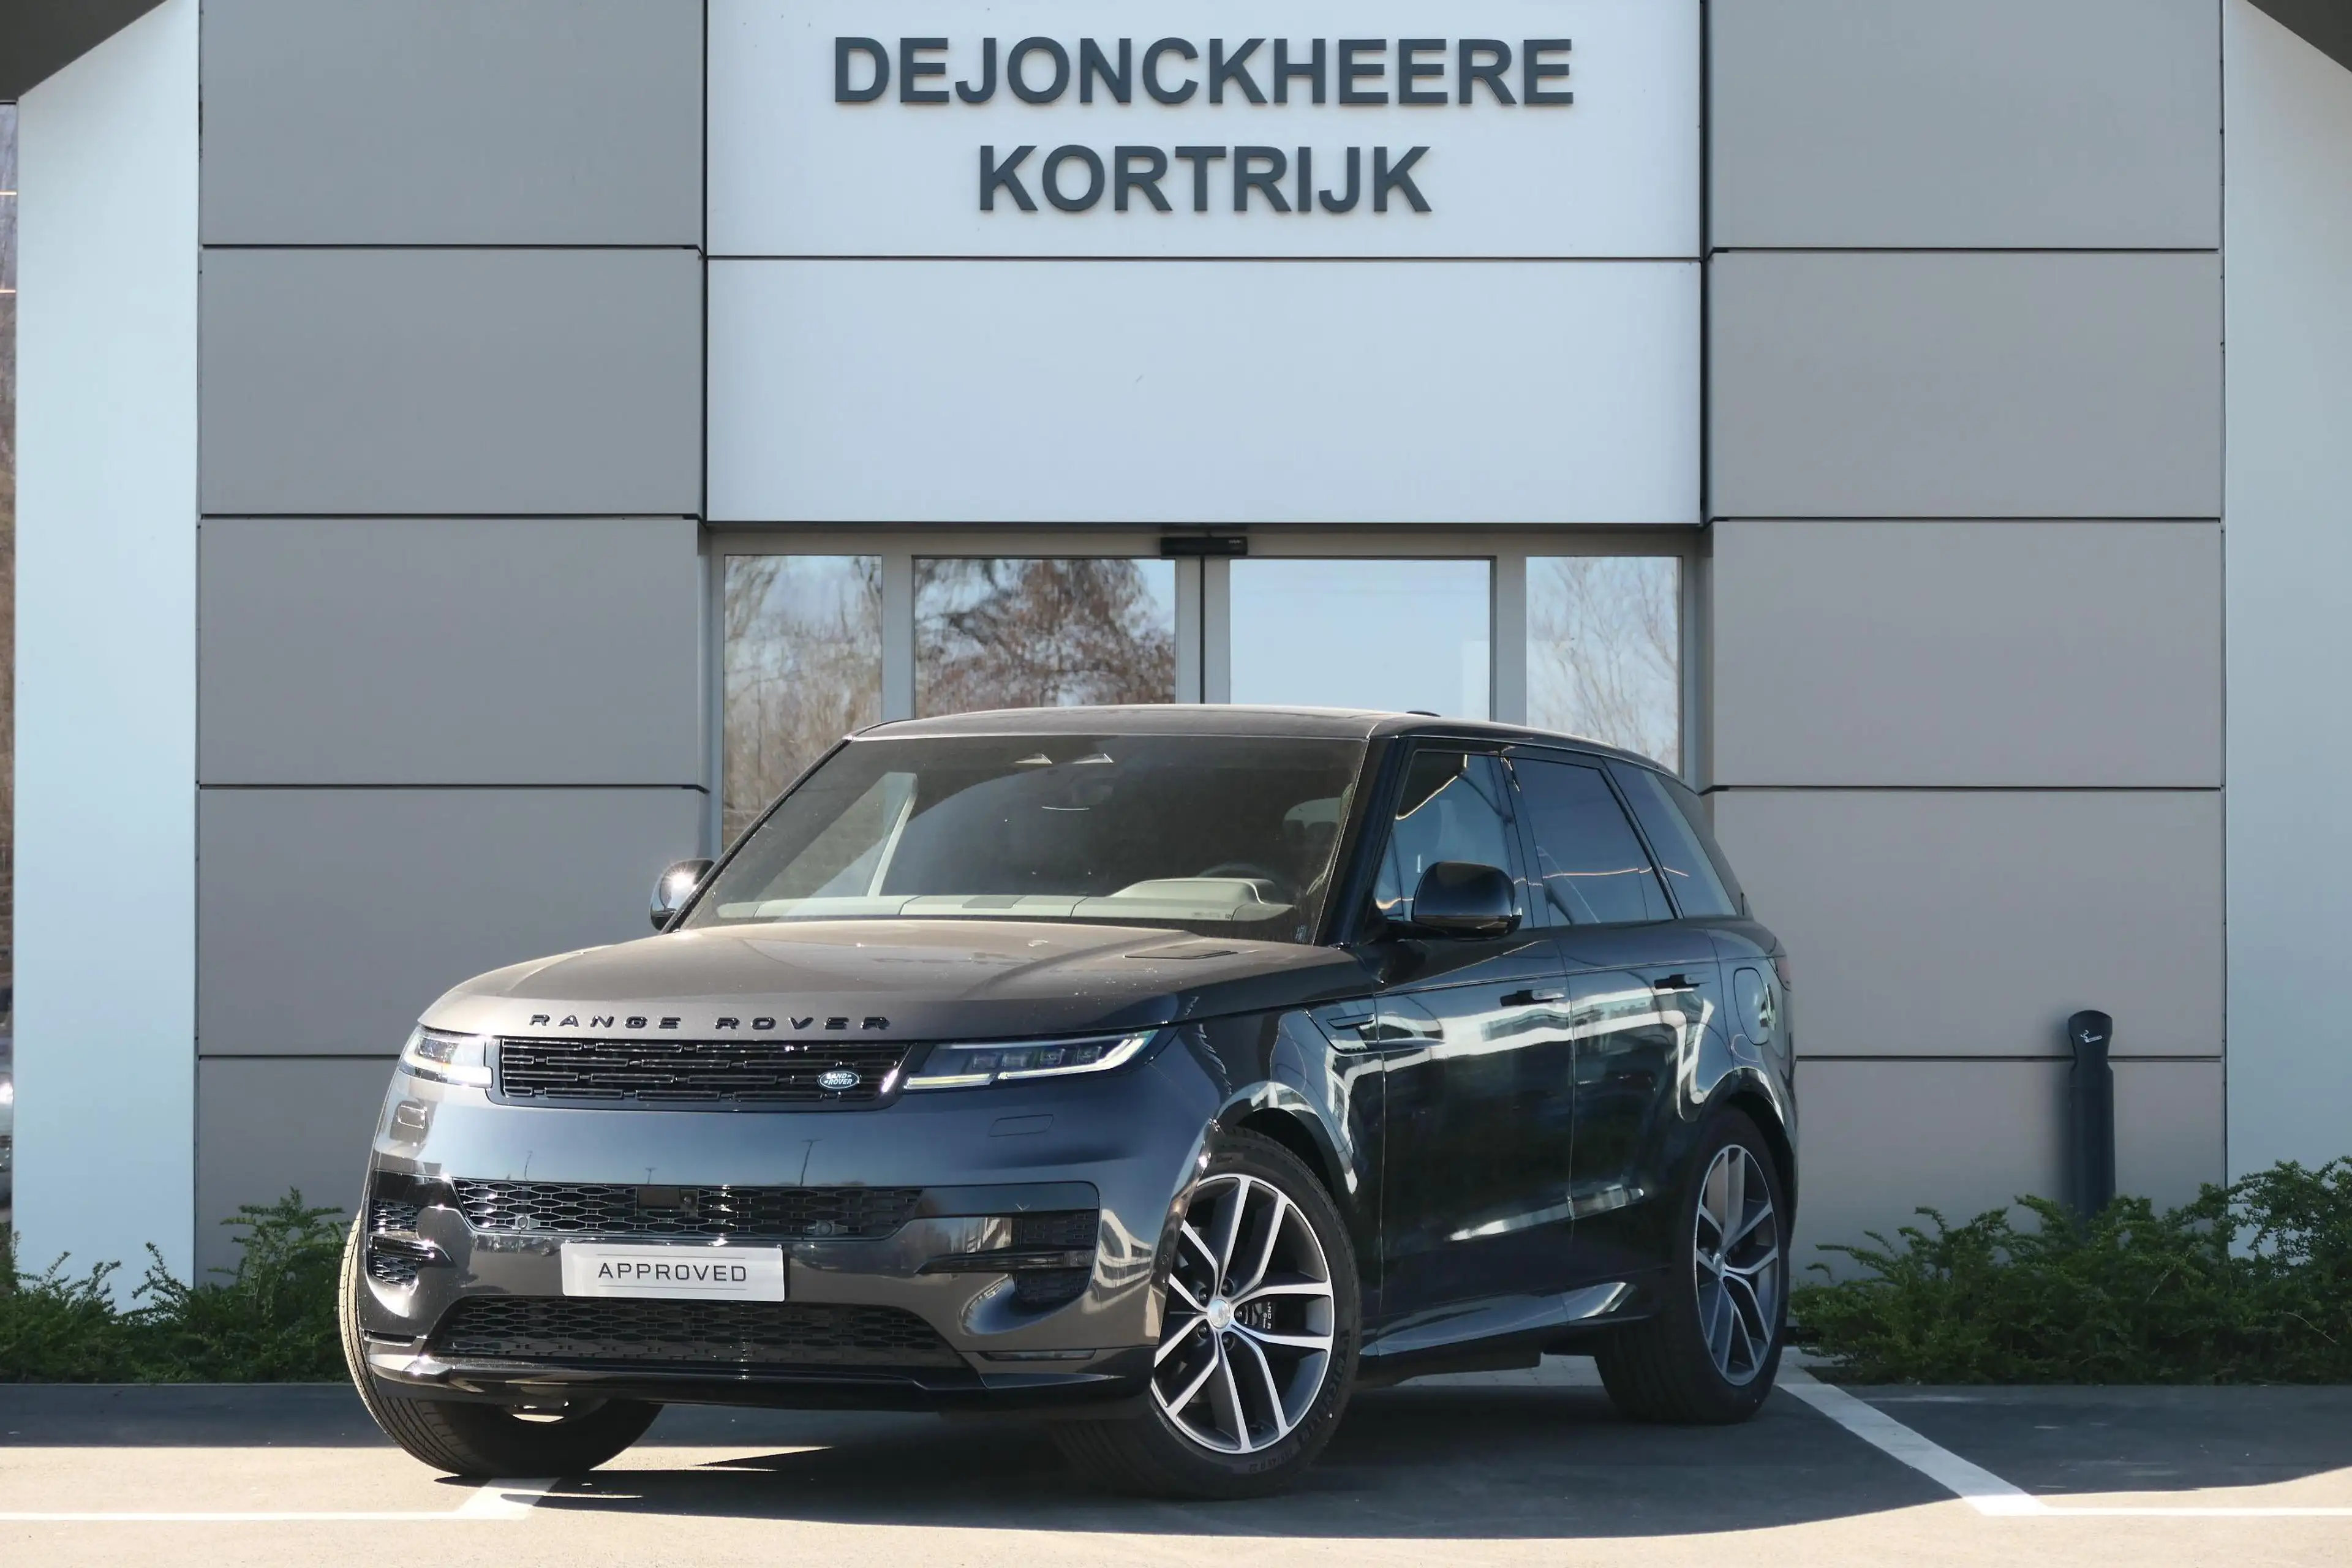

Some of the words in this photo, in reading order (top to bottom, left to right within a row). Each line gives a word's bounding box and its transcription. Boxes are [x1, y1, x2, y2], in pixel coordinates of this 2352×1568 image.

[834, 37, 1574, 107] DEJONCKHEERE
[979, 144, 1433, 214] KORTRIJK
[529, 1014, 682, 1030] RANGE
[715, 1016, 891, 1030] ROVER
[598, 1262, 747, 1283] APPROVED
